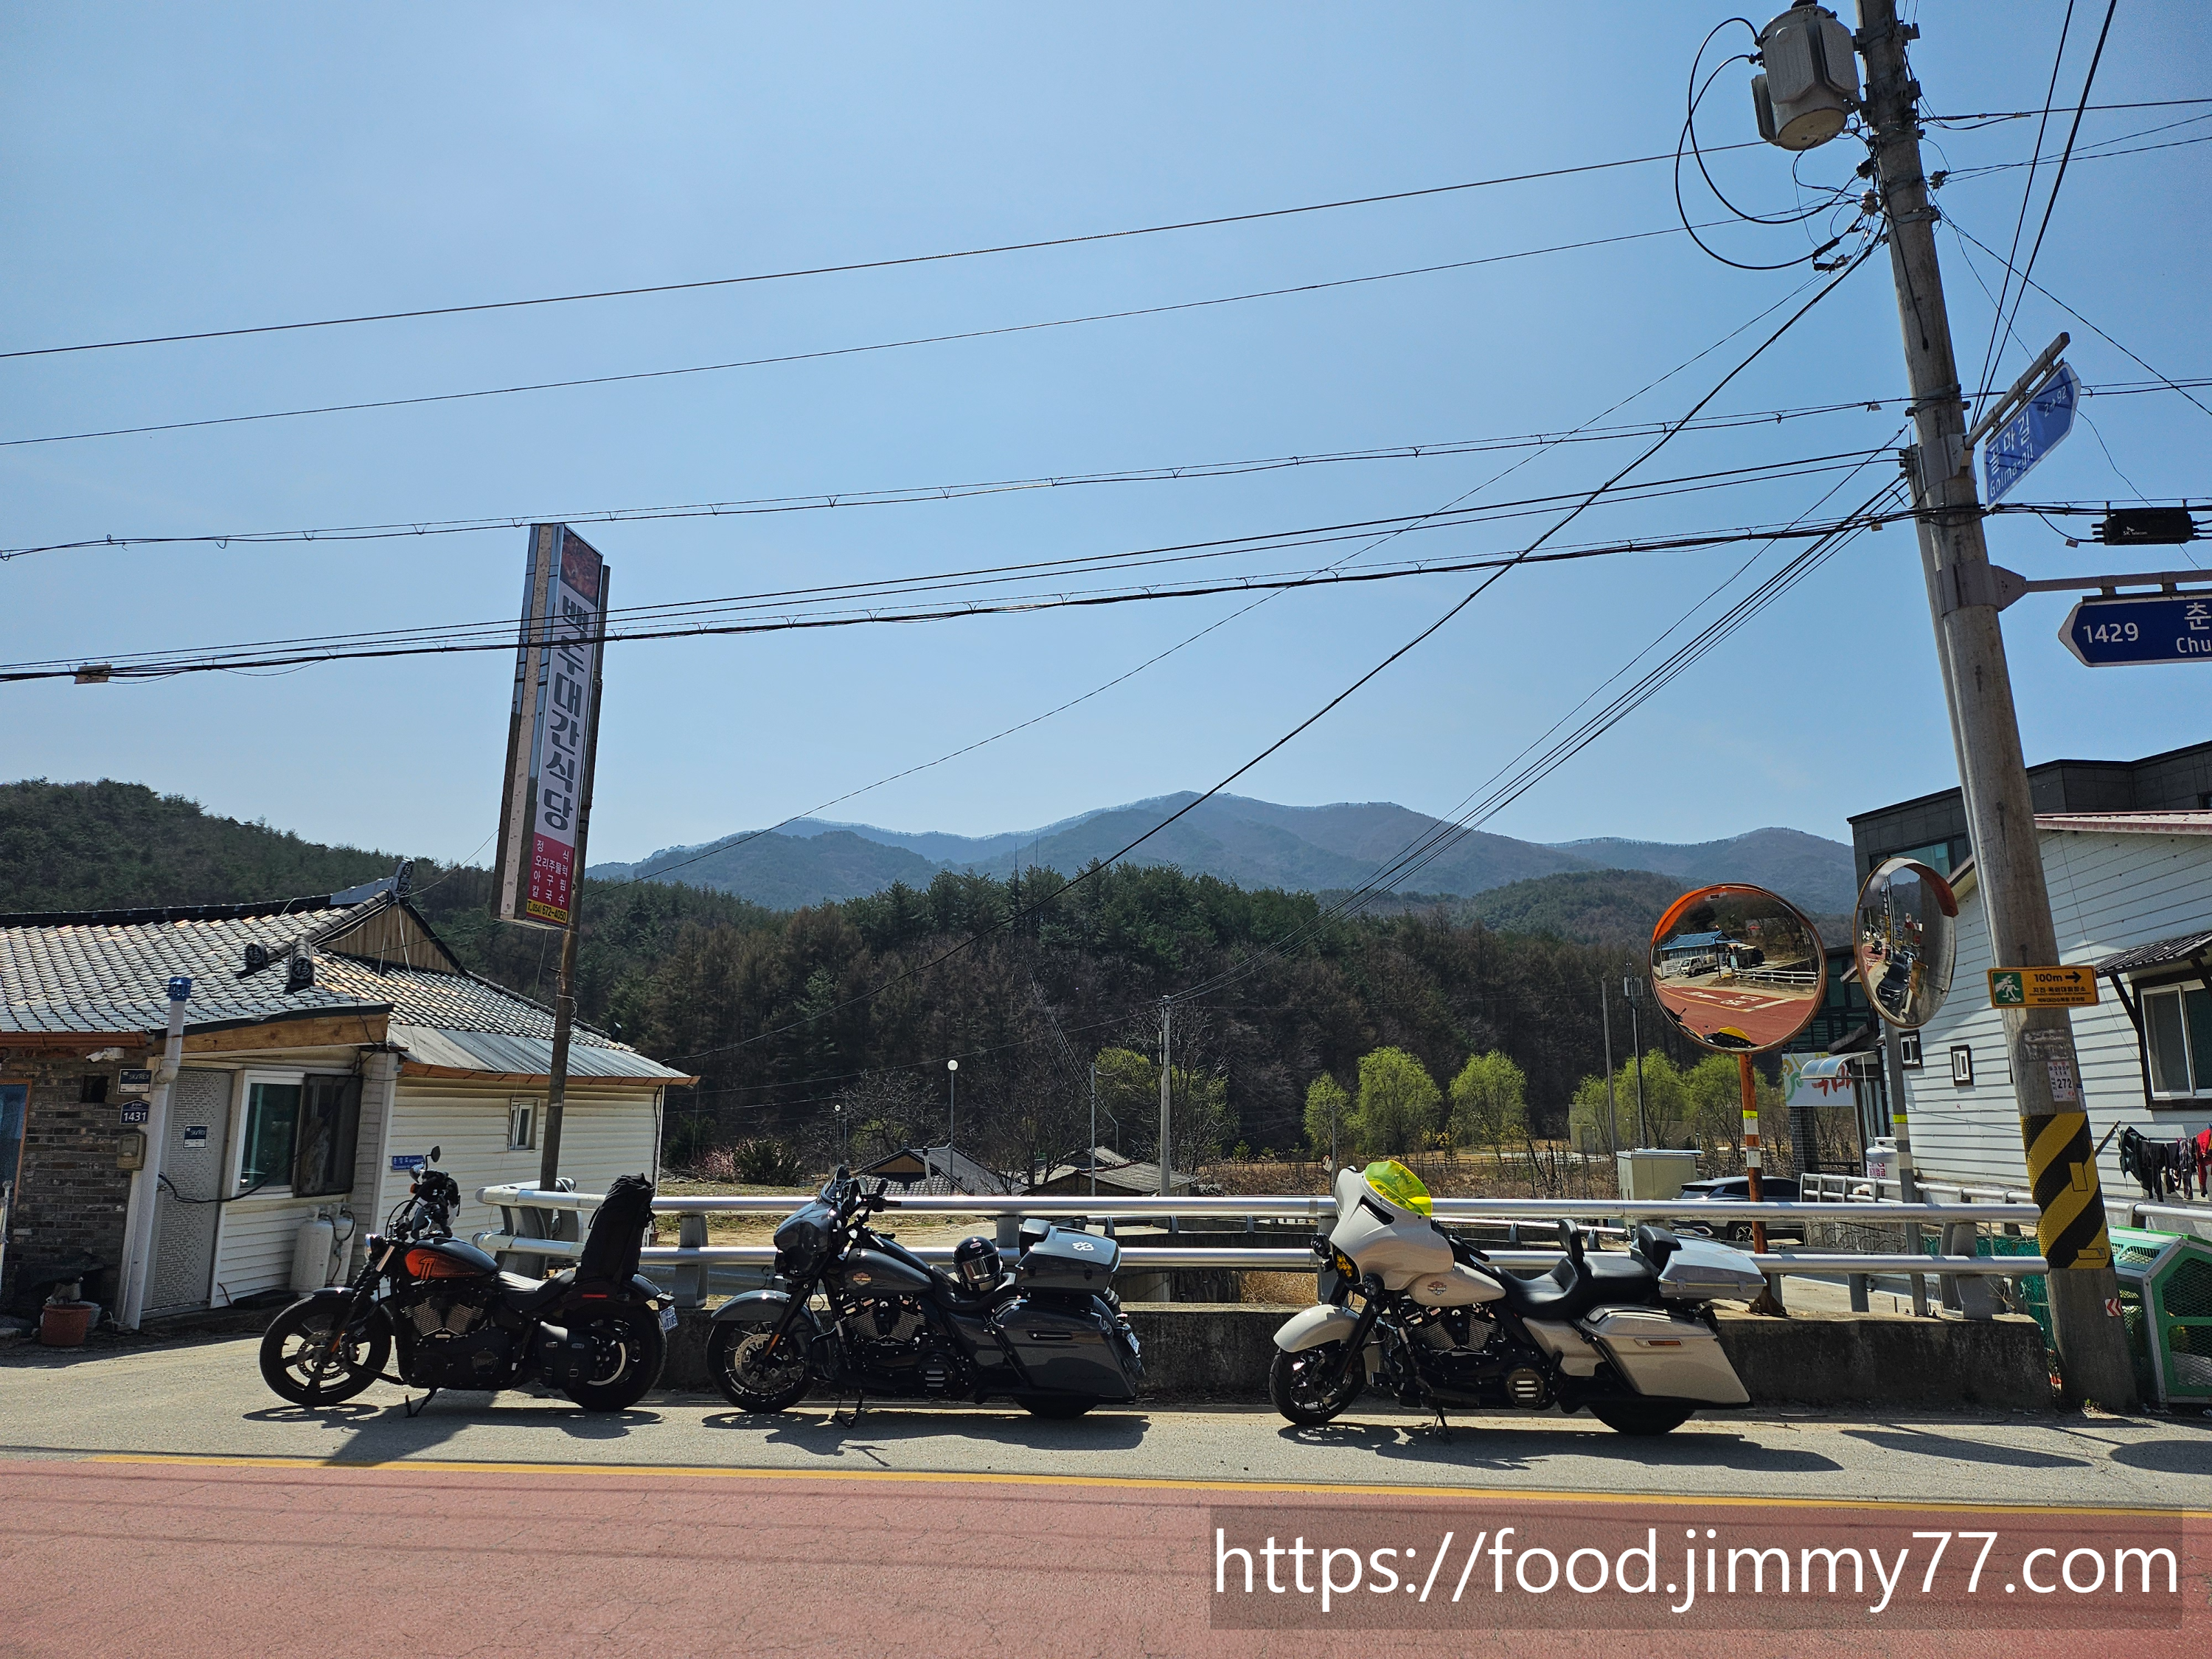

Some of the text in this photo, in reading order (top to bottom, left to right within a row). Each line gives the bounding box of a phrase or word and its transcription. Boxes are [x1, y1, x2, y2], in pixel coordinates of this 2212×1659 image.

[1989, 410, 2030, 476] 골마길
[1990, 442, 2034, 498] Golma-gil
[2184, 602, 2212, 630] 춘
[2083, 622, 2139, 644] 1429
[2176, 637, 2212, 653] Chu
[544, 594, 589, 831] 백두대간식당
[535, 855, 568, 877] 오리주물럭
[295, 961, 310, 975] 福
[2034, 973, 2063, 982] 100m
[2057, 1078, 2073, 1089] 272
[123, 1111, 147, 1121] 1431
